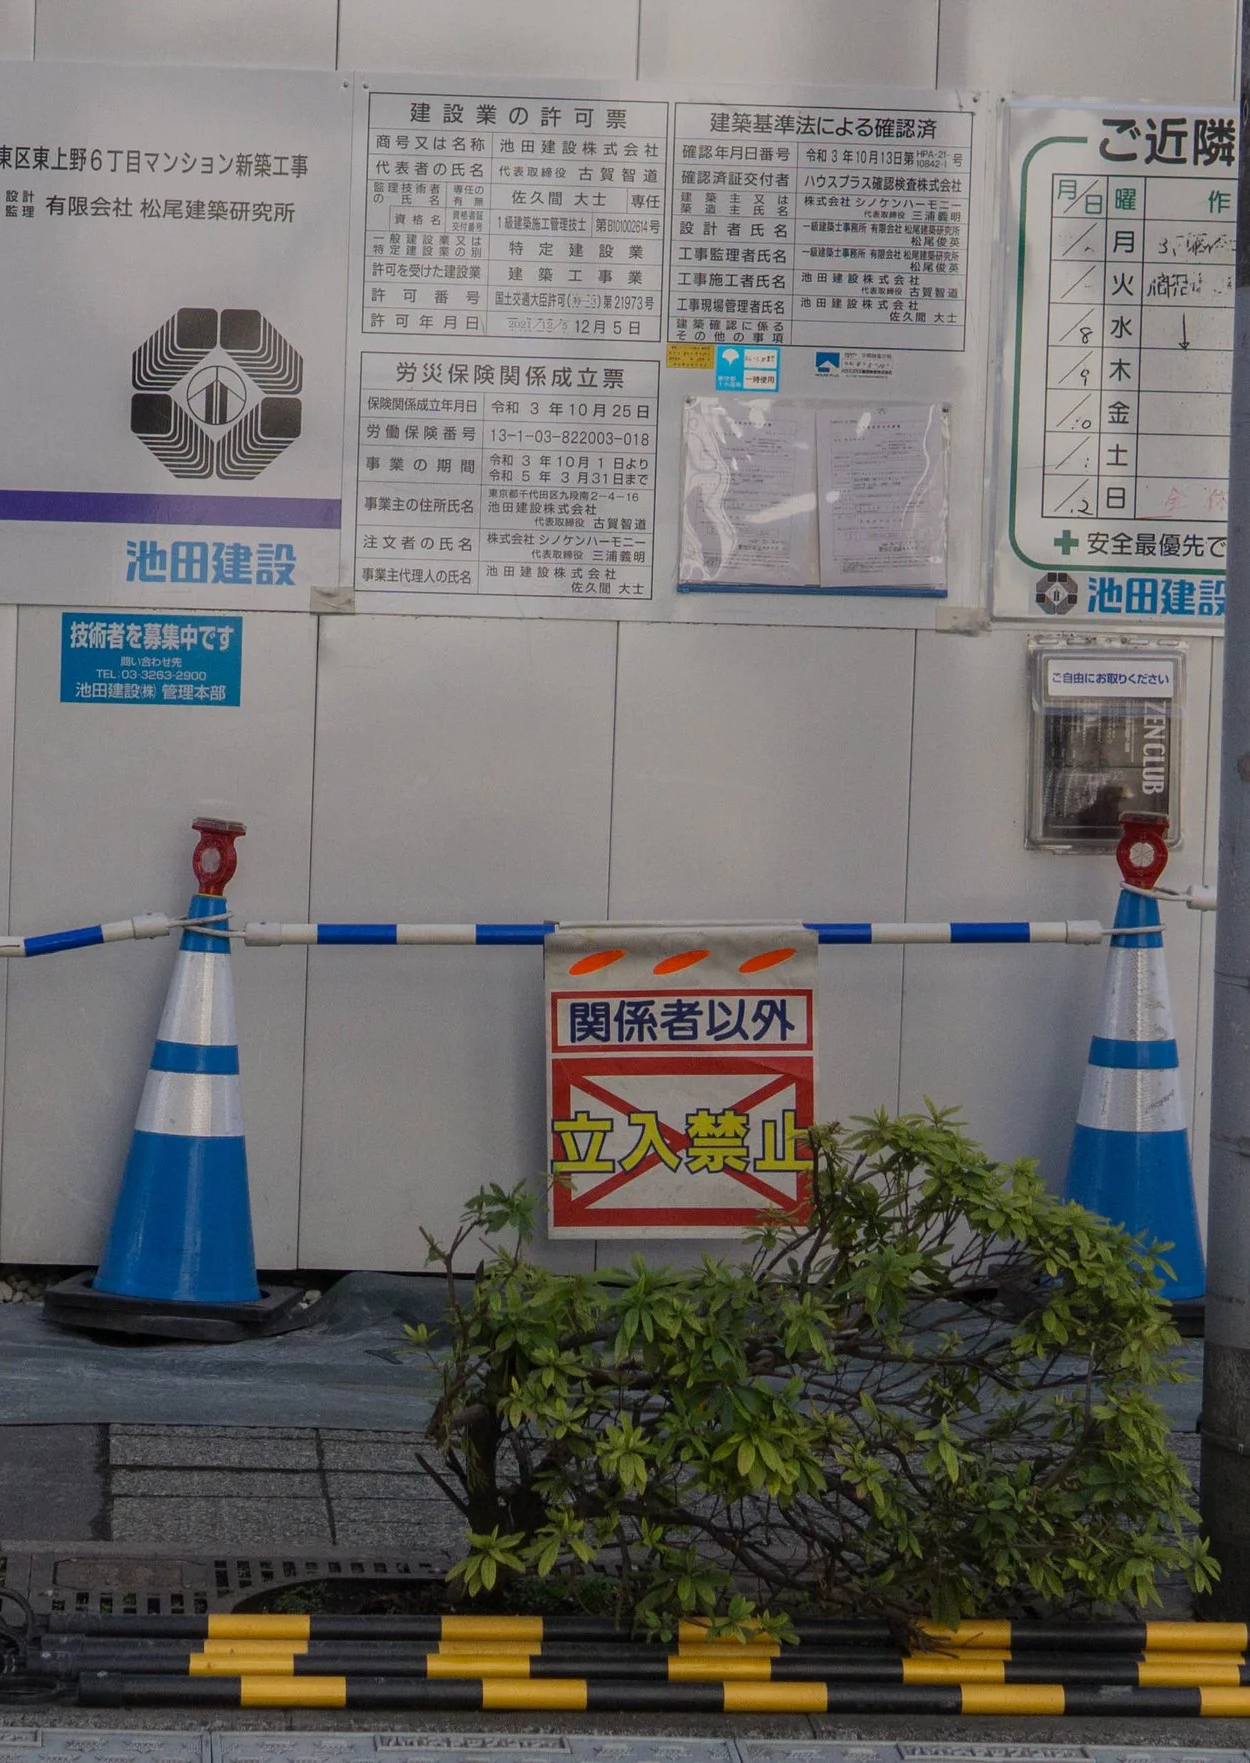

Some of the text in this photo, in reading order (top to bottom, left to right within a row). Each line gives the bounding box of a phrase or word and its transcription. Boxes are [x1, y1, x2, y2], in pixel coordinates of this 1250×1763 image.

[410, 102, 627, 129] 建設業の許可票
[710, 112, 937, 139] 建築基準法による確認済
[376, 134, 485, 152] 商号又は名称
[500, 138, 659, 158] 池田建設株式会社
[1100, 118, 1235, 166] ご近隣
[682, 144, 790, 162] 確認年月日番号
[376, 160, 483, 178] 代表者の氏名
[499, 165, 658, 183] 代表取締役 古賀智道
[682, 170, 790, 187] 確認済証交付者
[804, 174, 962, 193] ハウスプラス確認検査株式会社
[5, 190, 35, 203] 設計
[373, 181, 441, 195] 監理技術者
[1057, 179, 1077, 200] 月
[512, 189, 606, 207] 佐久間 大士
[631, 194, 660, 209] 専任
[681, 192, 788, 205] 建築主又は
[804, 195, 962, 210] 株式会社 シノケンハーモニー
[1085, 194, 1103, 214] 日
[1115, 188, 1136, 211] 曜
[1208, 190, 1231, 214] 作
[5, 204, 35, 218] 監理
[45, 194, 295, 223] 有限会社 松尾建築研究所
[394, 213, 441, 226] 資格名
[679, 220, 787, 238] 設計者氏名
[509, 241, 643, 259] 特定建設業
[1113, 230, 1135, 253] 月
[678, 246, 787, 264] 工事監理者氏名
[372, 262, 481, 280] 許可を受けた建設業
[508, 266, 643, 285] 建築工事業
[801, 271, 920, 286] 池田建設株式会社
[678, 272, 786, 289] 工事施工者氏名
[1112, 272, 1134, 296] 火
[371, 287, 480, 305] 許可番号
[800, 297, 919, 311] 池田建設株式会社
[676, 297, 785, 315] 工事現場管理者氏名
[370, 312, 479, 330] 許可年月日
[1110, 315, 1133, 339] 水
[396, 361, 625, 389] 労災保険関係成立票
[1109, 358, 1131, 381] 木
[367, 396, 477, 413] 保険関係成立年月日
[1108, 400, 1130, 424] 金
[366, 424, 476, 441] 労働保険番号
[491, 428, 649, 446] 13-1-03-822003-018
[1106, 443, 1128, 466] 土
[366, 456, 475, 474] 事業の期間
[364, 496, 474, 514] 事業主の住所氏名
[1107, 487, 1125, 509] 日
[488, 501, 597, 516] 池田建設株式会社
[535, 517, 646, 530] 代表取締役 古賀智道
[363, 534, 472, 552] 注文者の氏名
[487, 532, 646, 548] 株式会社 シノケンハーモニー
[1087, 531, 1227, 558] 安全最優先で
[126, 540, 296, 586] 池田建設
[531, 549, 646, 563] 代表取締役 三浦義明
[362, 567, 471, 585] 事業主代理人の氏名
[486, 565, 617, 580] 池田建設株式会社
[571, 582, 644, 595] 佐久間 大士
[1088, 576, 1226, 616] 池田建設
[70, 621, 234, 651] 技術者を募集中です
[120, 656, 183, 668] 問い合わせ先
[1051, 672, 1170, 685] ご自由にお取りください
[161, 684, 227, 701] 管理本部
[1142, 743, 1166, 795] CLUB
[569, 998, 795, 1043] 関係者以外
[550, 1107, 815, 1176] 立入禁止
